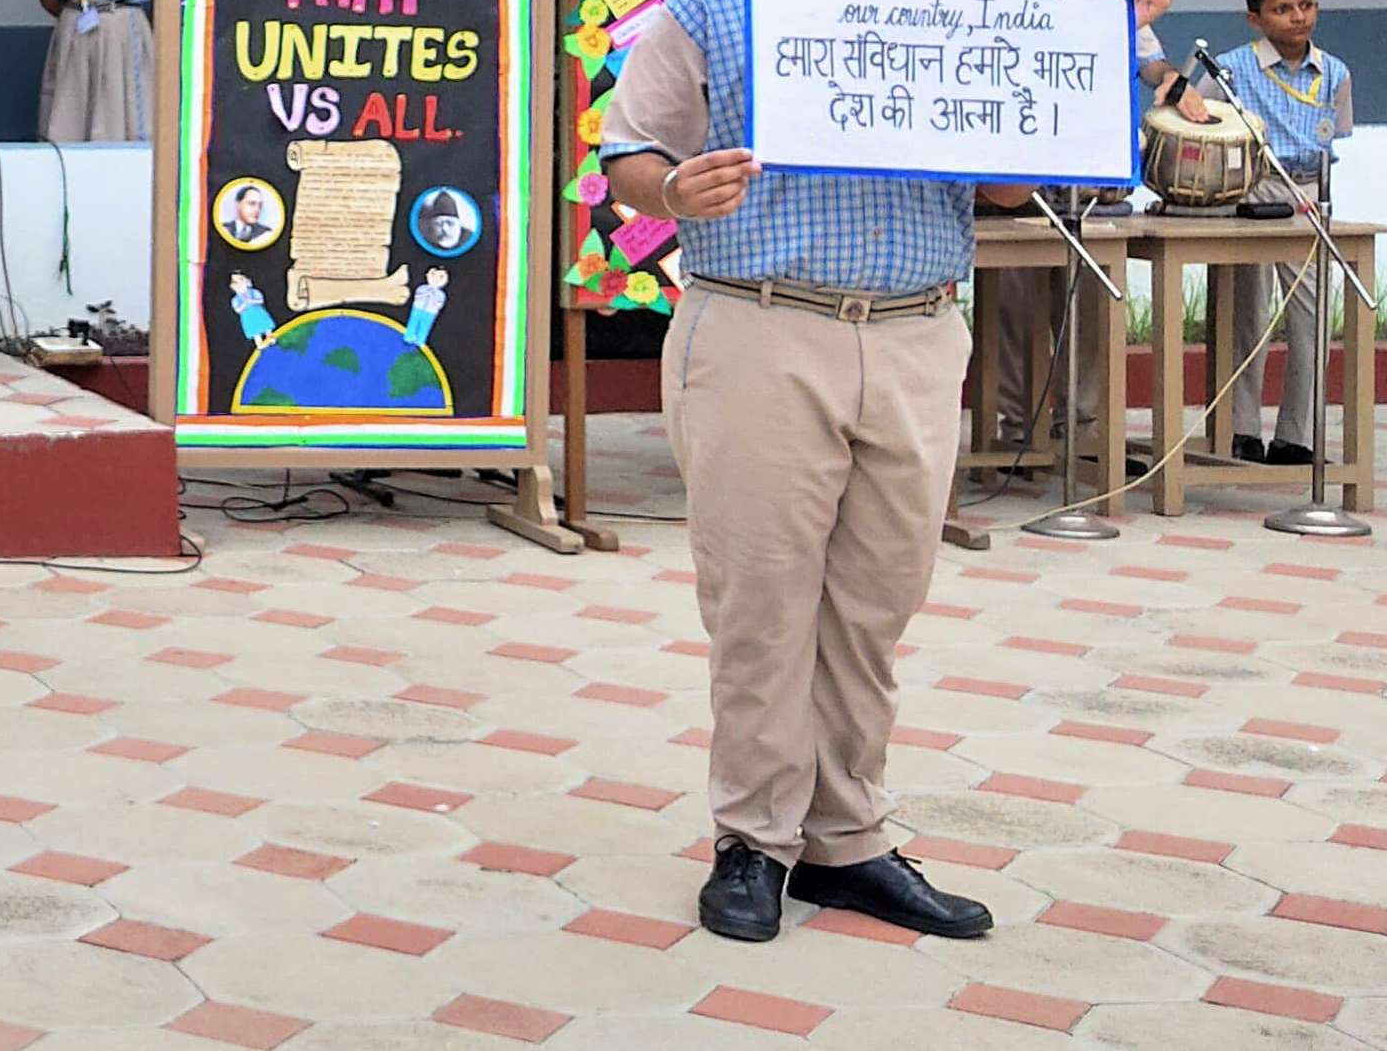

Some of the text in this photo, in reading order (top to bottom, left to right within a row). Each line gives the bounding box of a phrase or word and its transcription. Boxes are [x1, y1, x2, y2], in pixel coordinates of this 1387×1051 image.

[837, 1, 881, 26] our
[236, 19, 480, 82] UNITES
[776, 32, 1099, 92] हमारा संविधान हमारे भारत
[353, 91, 464, 141] ALL.
[829, 80, 876, 132] देश
[880, 83, 915, 130] की
[929, 98, 1005, 136] आत्मा
[1017, 87, 1042, 137] है
